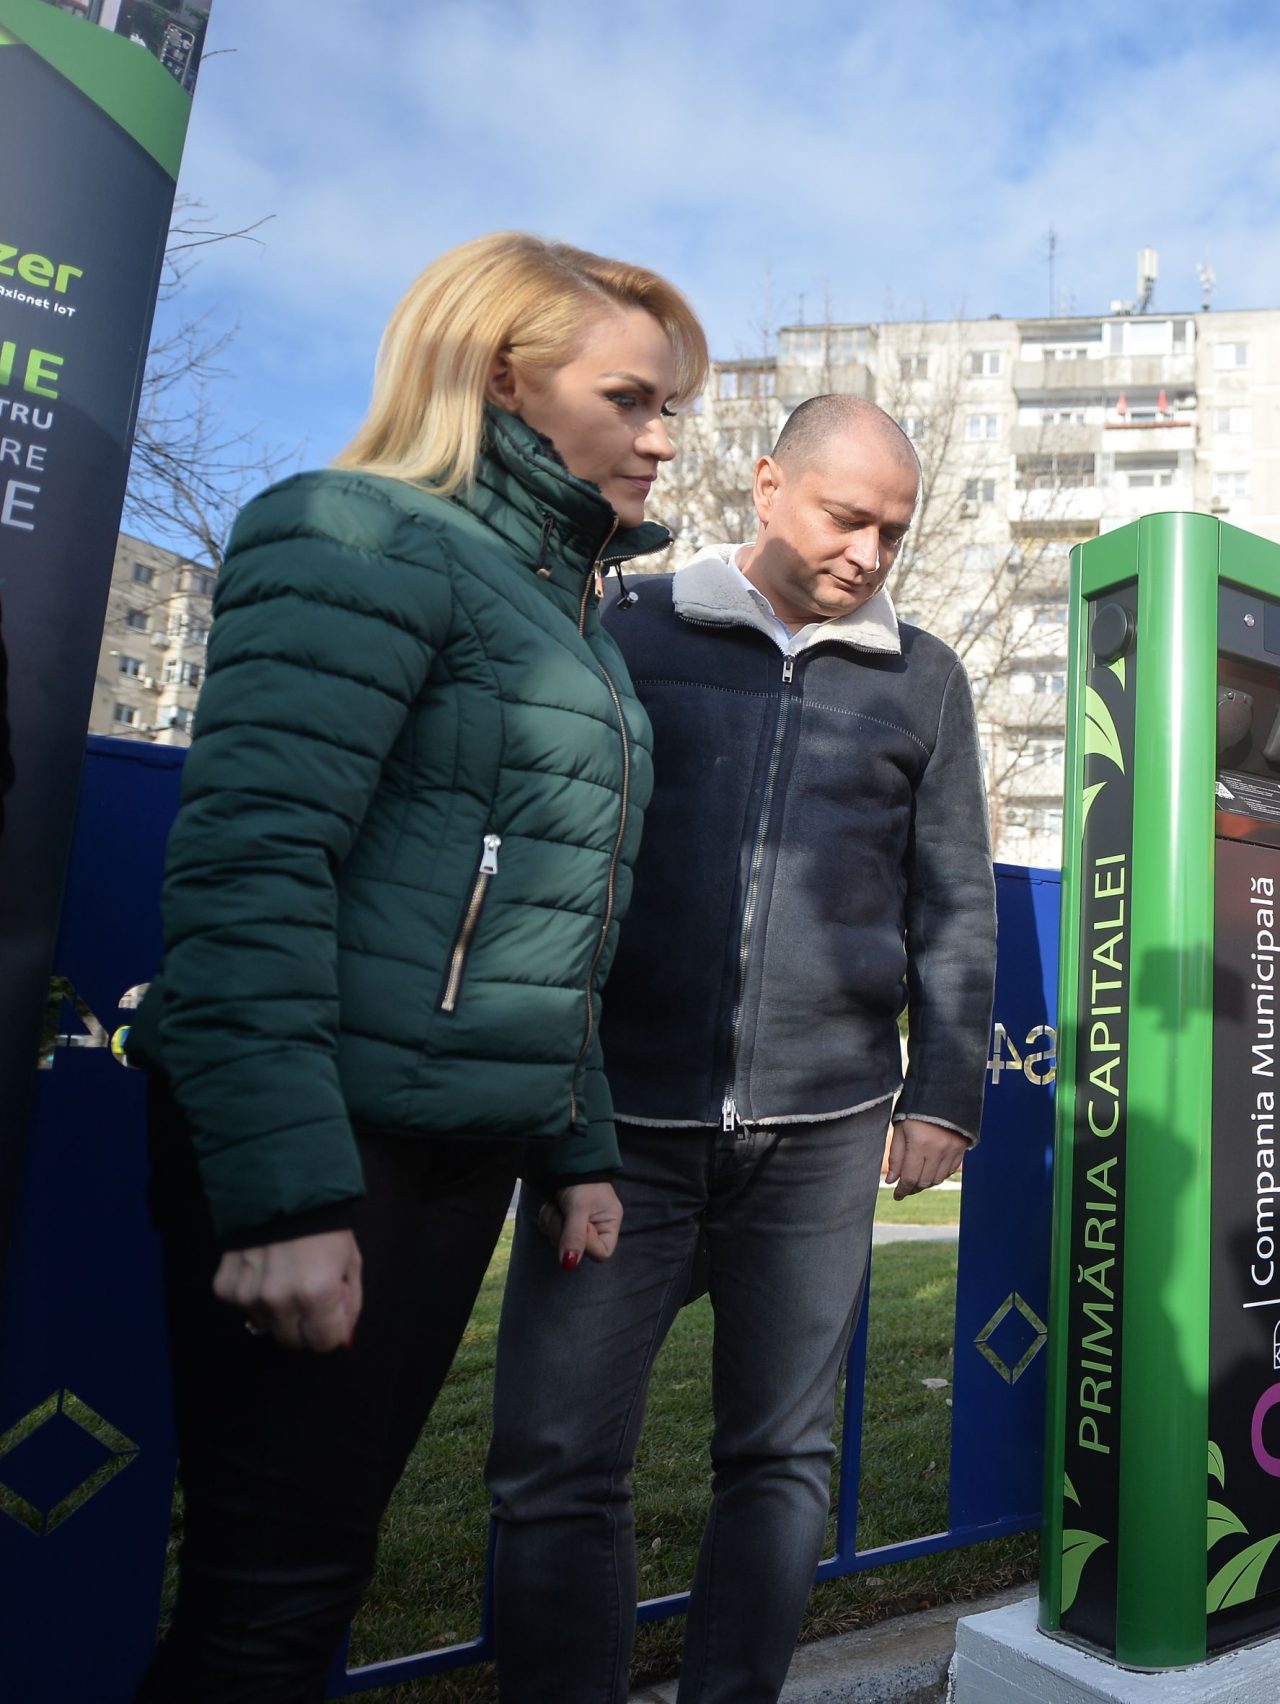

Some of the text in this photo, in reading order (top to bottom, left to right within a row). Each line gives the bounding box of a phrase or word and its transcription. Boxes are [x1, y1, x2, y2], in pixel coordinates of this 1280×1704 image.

[1077, 853, 1126, 1455] PRIMĂRIA CAPITALEI
[1250, 876, 1280, 1078] Municipală
